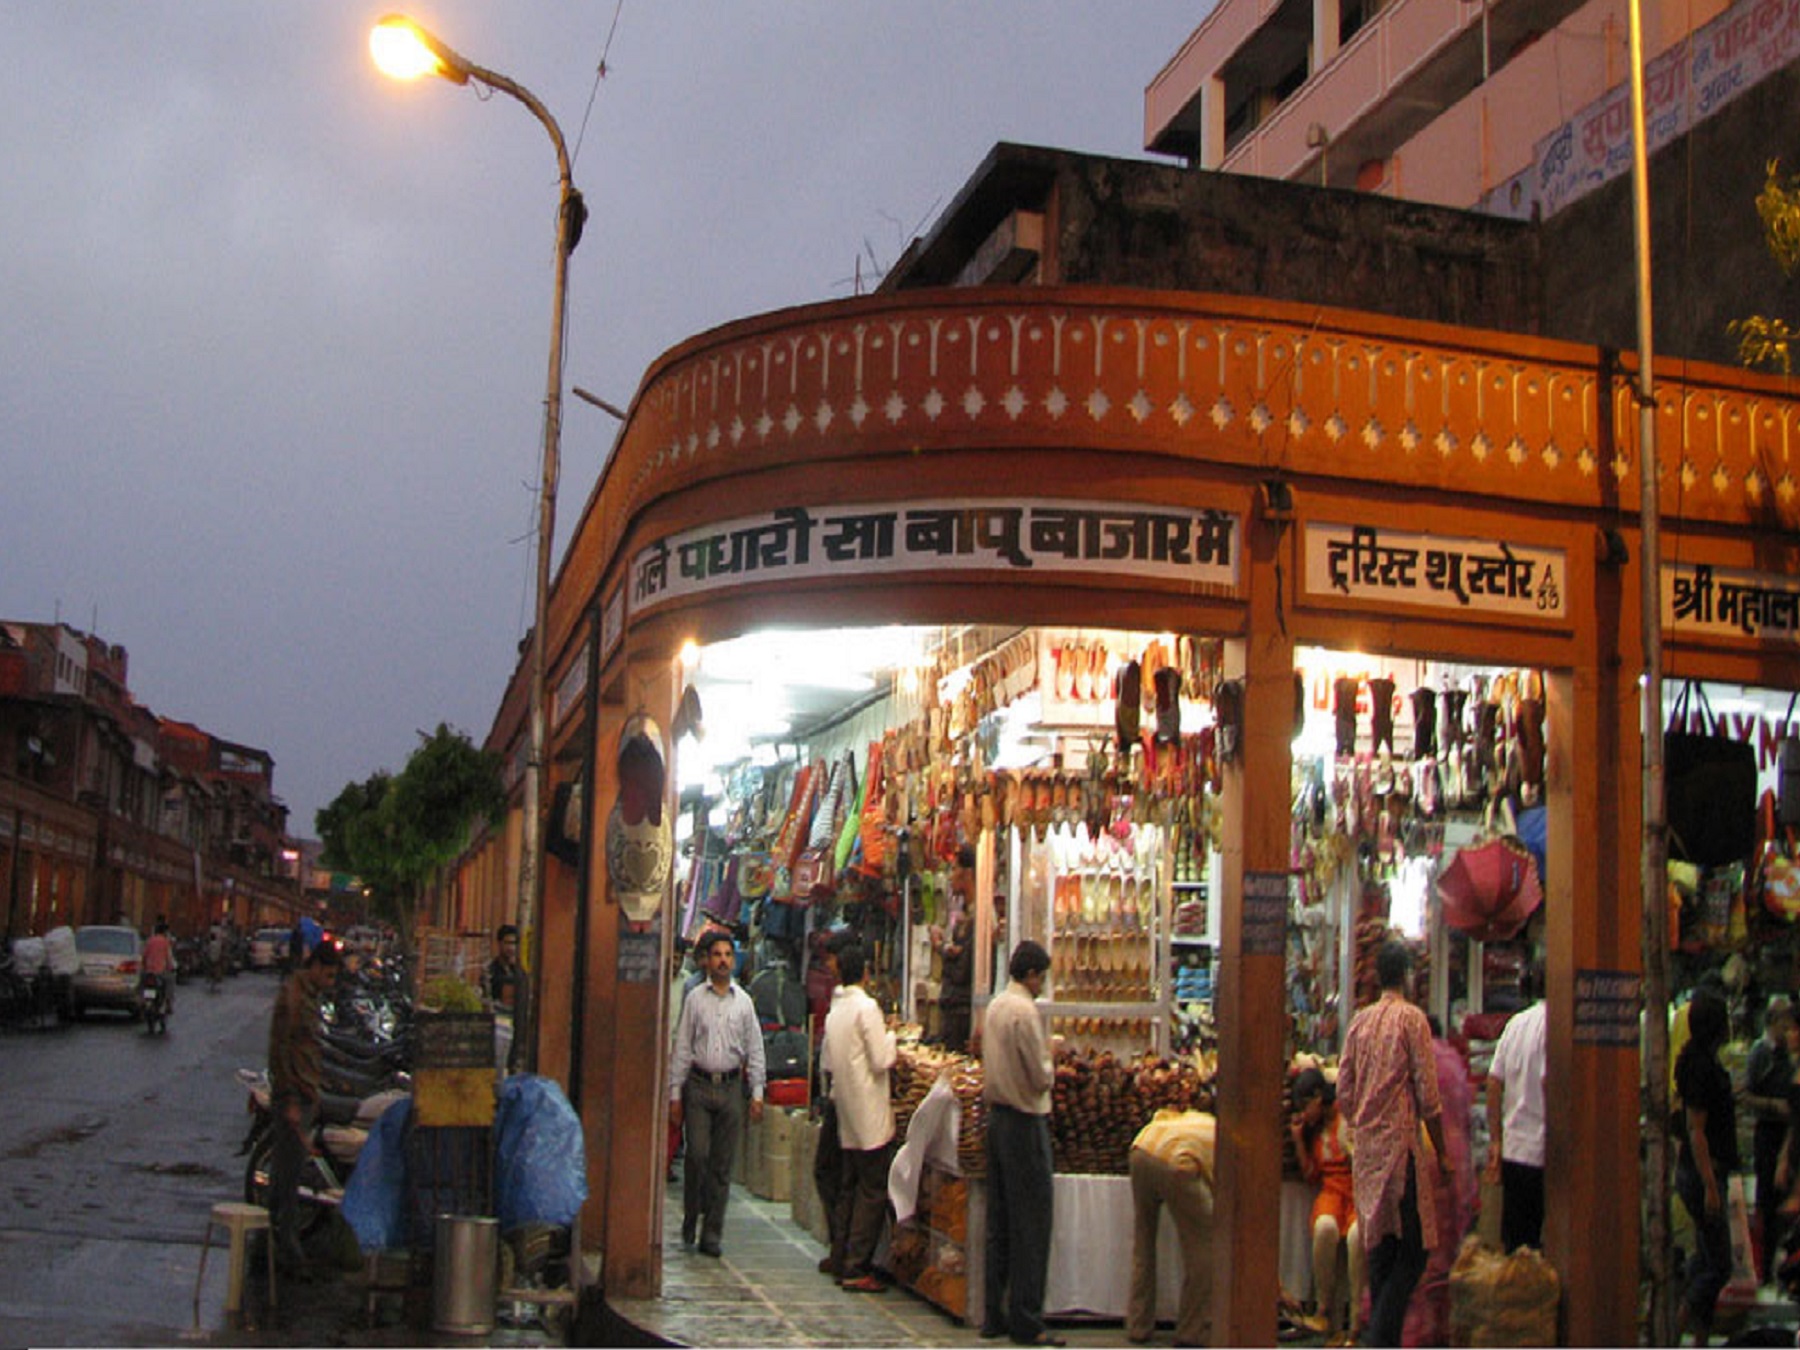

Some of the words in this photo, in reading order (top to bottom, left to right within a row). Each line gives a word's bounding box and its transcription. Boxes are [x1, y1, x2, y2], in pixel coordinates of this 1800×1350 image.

[906, 507, 1033, 566] बापू
[1030, 510, 1193, 565] बाजार
[1197, 509, 1233, 566] में
[1327, 527, 1419, 594] टूरिस्ट
[1425, 551, 1469, 604] शू
[1467, 541, 1535, 598] स्टोर
[1674, 564, 1713, 622] श्री
